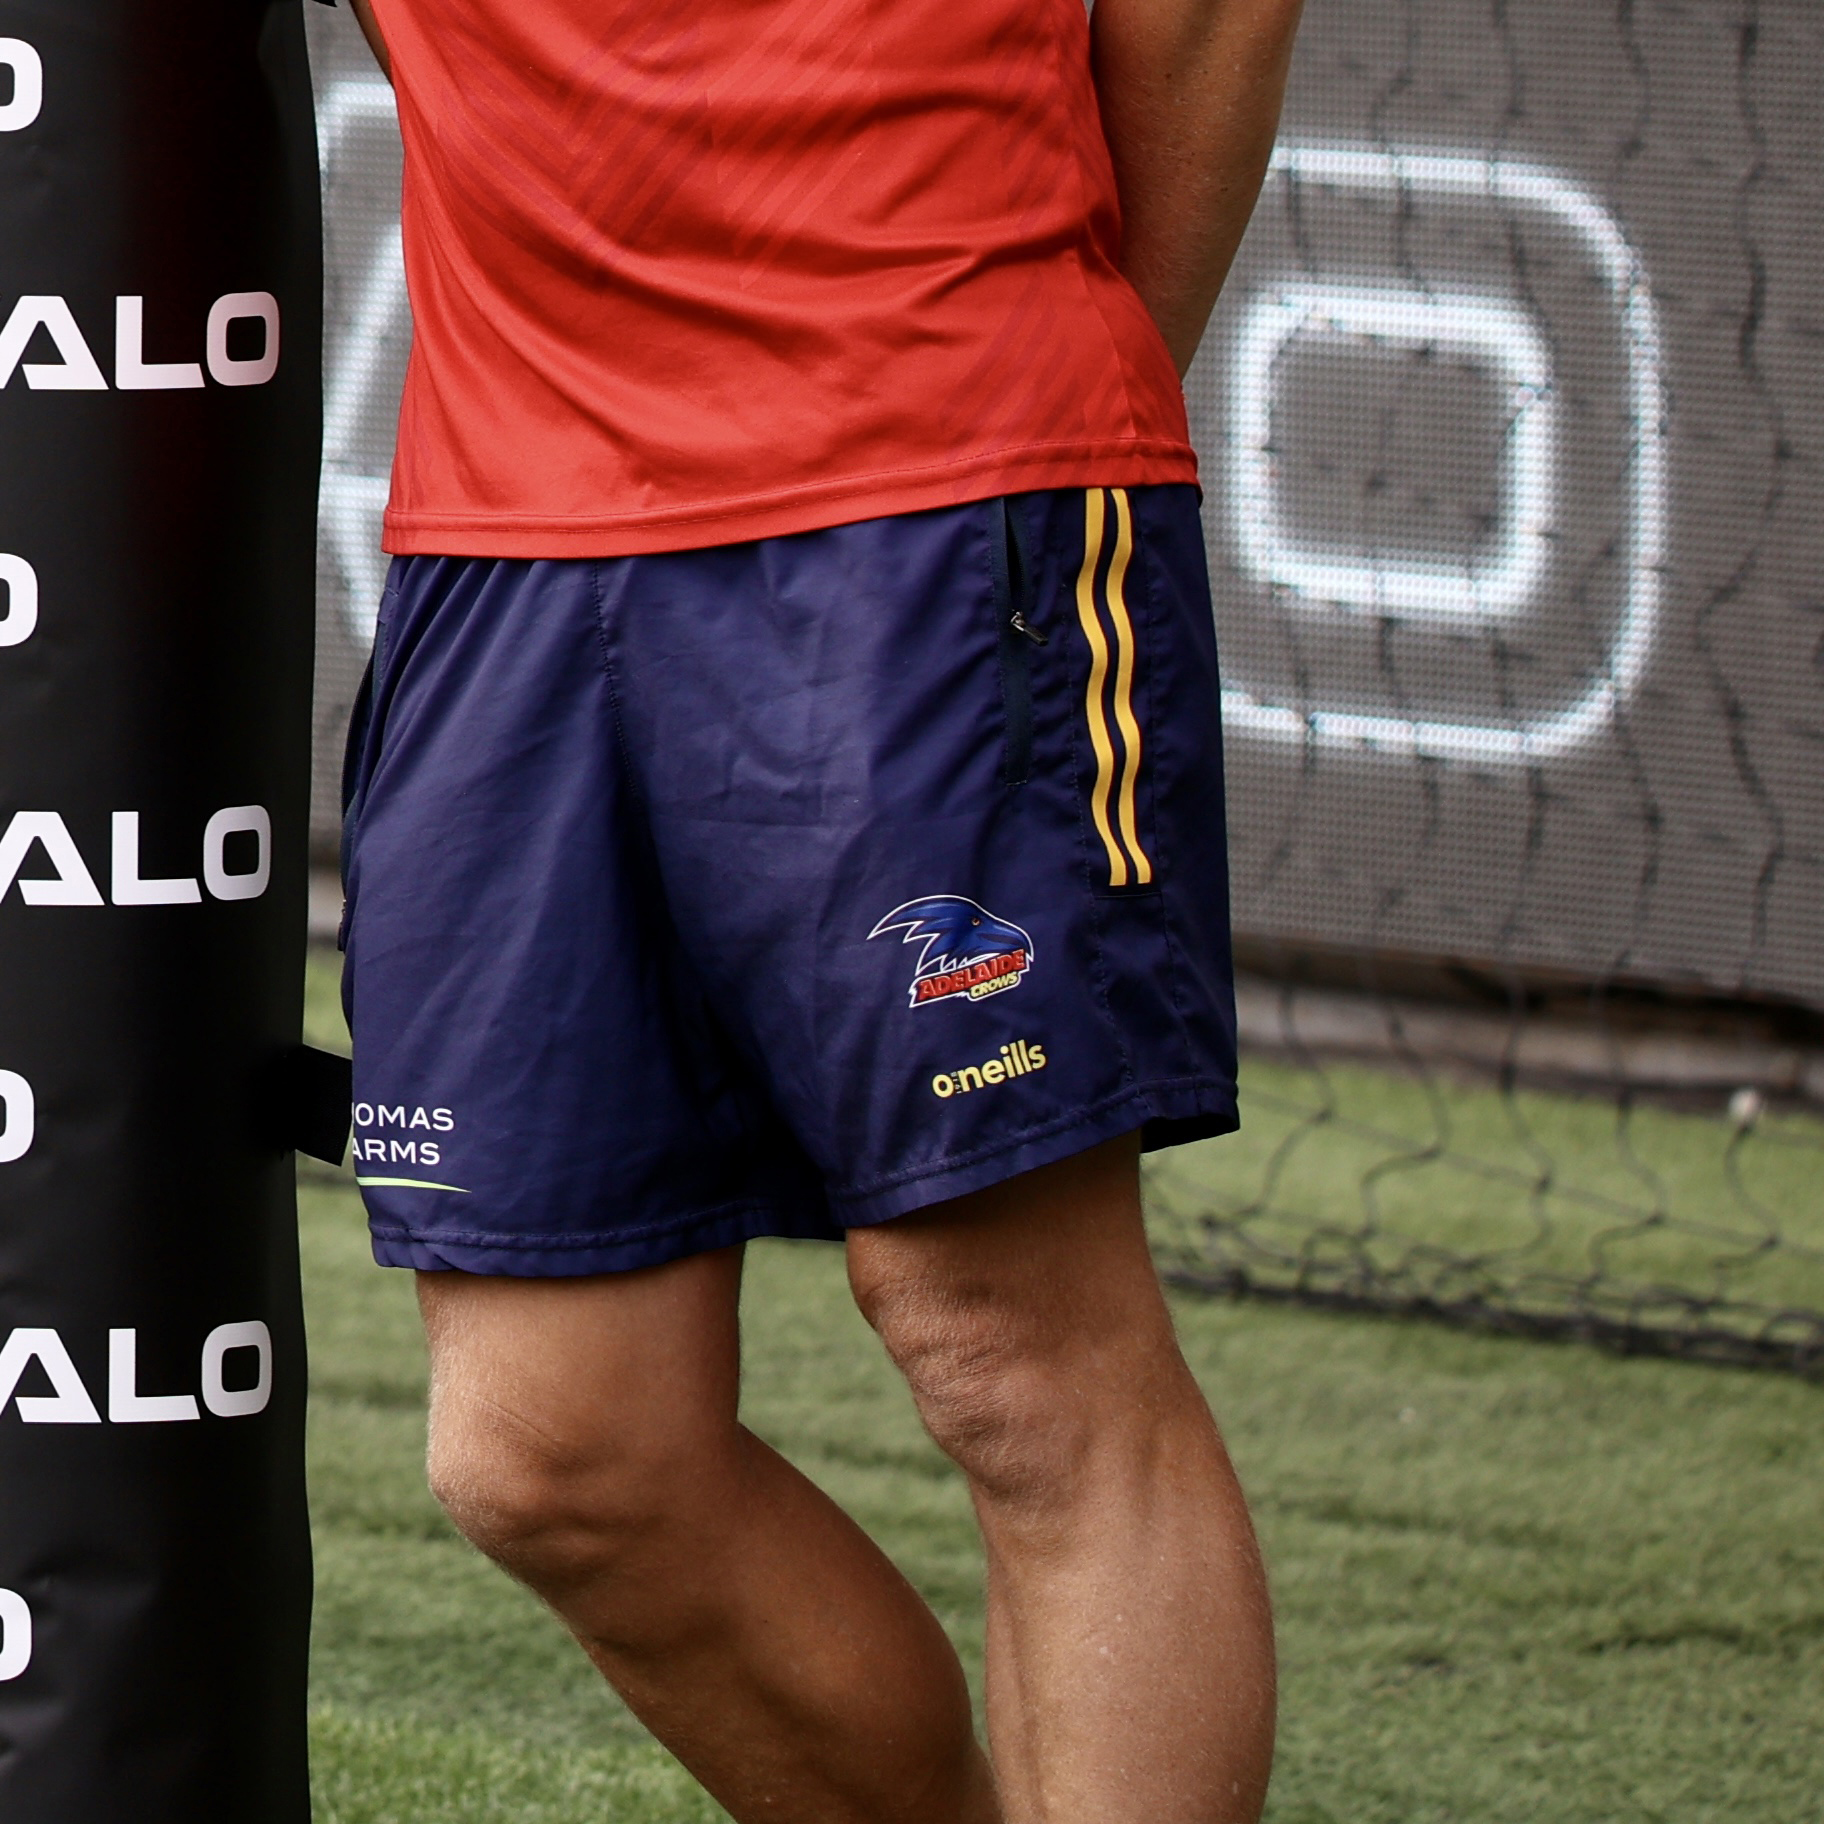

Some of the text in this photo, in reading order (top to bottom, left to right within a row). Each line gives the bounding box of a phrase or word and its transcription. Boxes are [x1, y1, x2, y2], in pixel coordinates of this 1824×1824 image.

[918, 949, 1025, 1001] ADELAIDE
[970, 972, 1019, 998] CROWS
[352, 1102, 454, 1131] OMAS
[352, 1137, 441, 1165] ARMS
